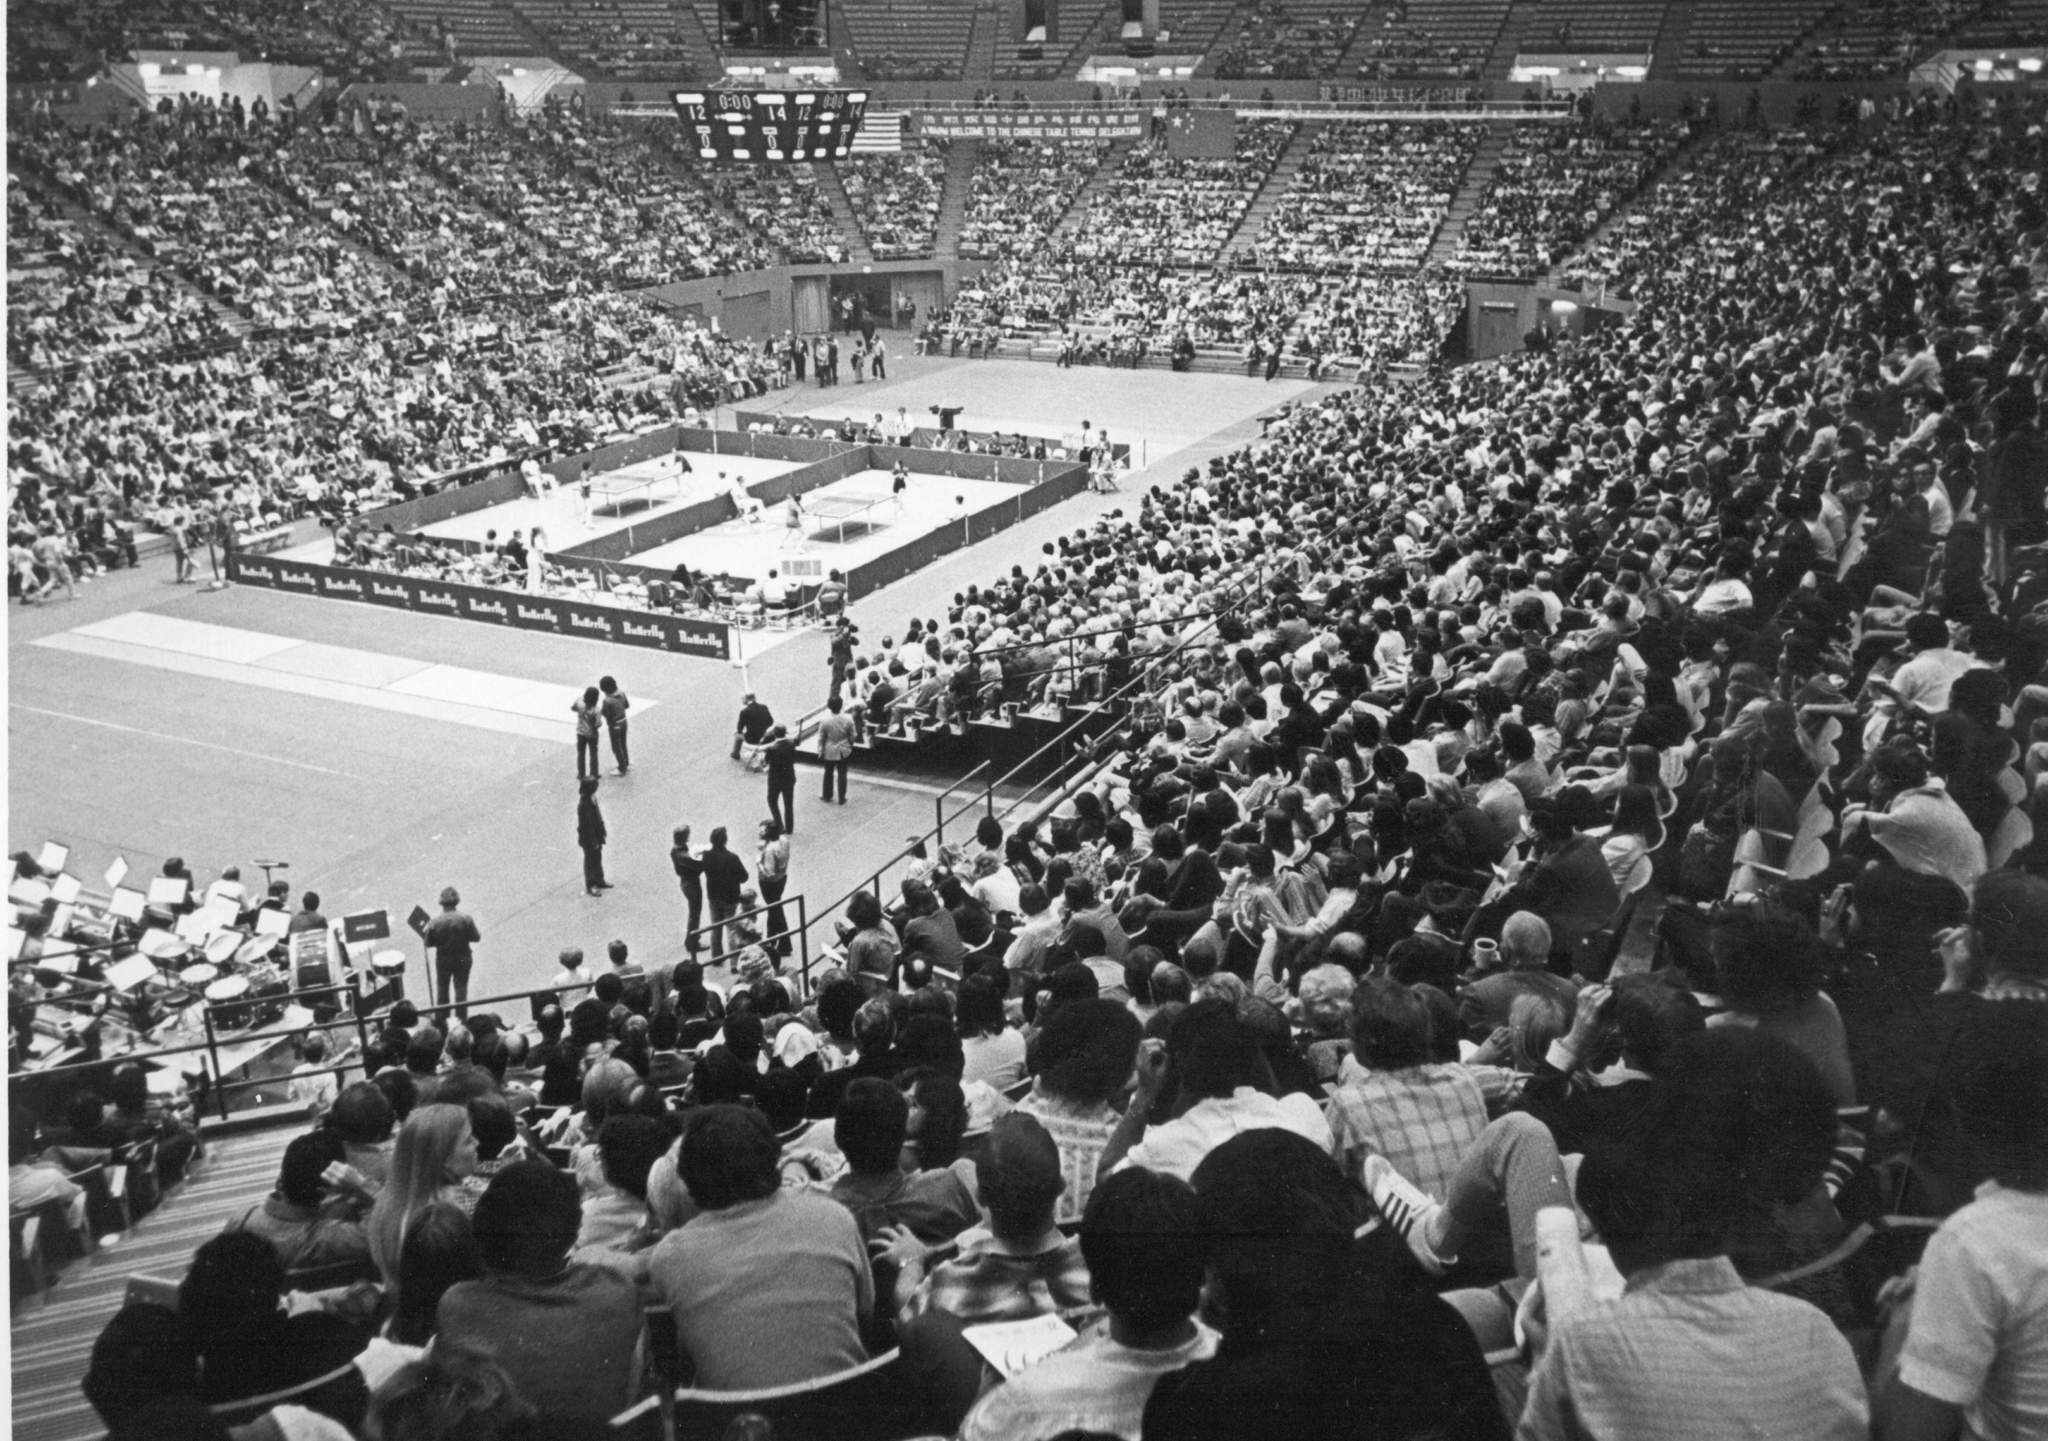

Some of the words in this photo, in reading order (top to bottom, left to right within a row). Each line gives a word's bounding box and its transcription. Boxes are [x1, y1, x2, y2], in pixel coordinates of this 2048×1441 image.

[719, 94, 751, 110] 0:00
[689, 105, 706, 120] 12
[768, 106, 786, 121] 14
[798, 106, 809, 121] 12
[850, 104, 862, 118] 14
[921, 126, 927, 134] A
[950, 127, 984, 136] WELCOME
[986, 127, 996, 135] TO
[998, 127, 1011, 136] THE
[1013, 127, 1043, 136] CHINESE
[1045, 127, 1068, 136] TABLE
[1070, 127, 1096, 136] TENNIS
[1099, 126, 1141, 136] DELEGATION
[239, 564, 273, 579] Butterfly
[281, 570, 316, 585] Butterfly
[325, 577, 362, 592] Butterfly
[373, 582, 409, 599] Butterfly
[420, 590, 457, 607] Butterfly
[469, 597, 507, 616] Butterfly
[517, 604, 557, 624] Butterfly
[571, 612, 611, 632] Butterfly
[623, 621, 664, 639] Butterfly
[679, 630, 722, 648] Butterfly
